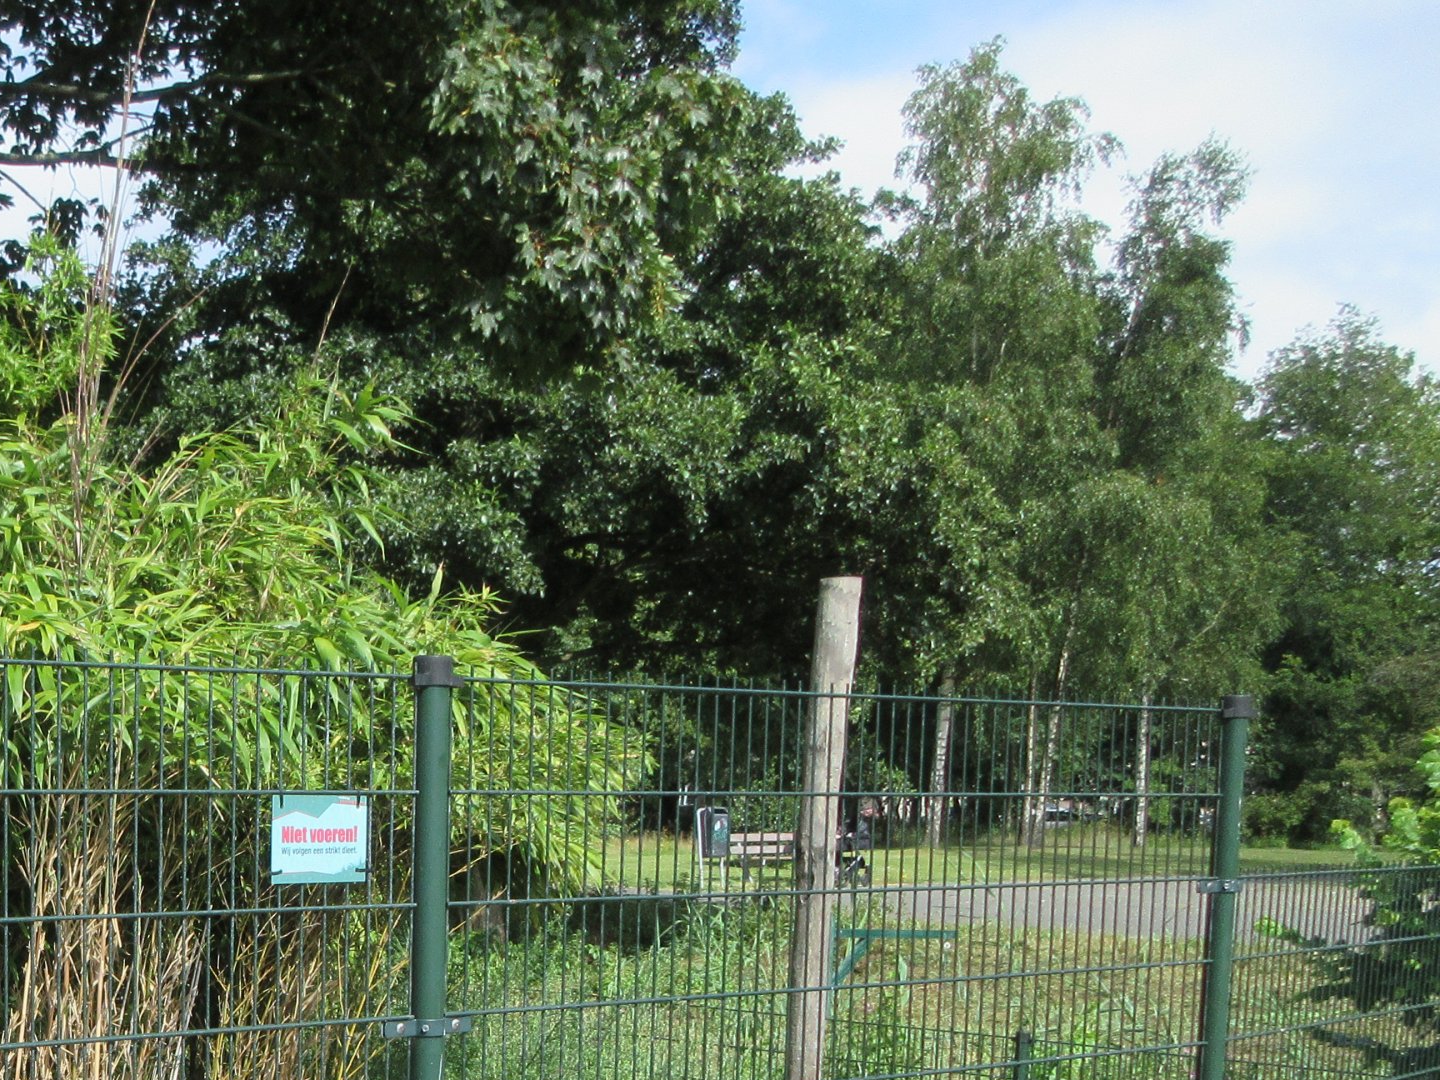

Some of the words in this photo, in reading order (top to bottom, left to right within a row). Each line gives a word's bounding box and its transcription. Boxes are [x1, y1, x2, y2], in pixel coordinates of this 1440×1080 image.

[281, 825, 307, 843] Niet
[310, 825, 358, 843] voeren!
[281, 847, 291, 856] Wij
[292, 847, 312, 856] volgen
